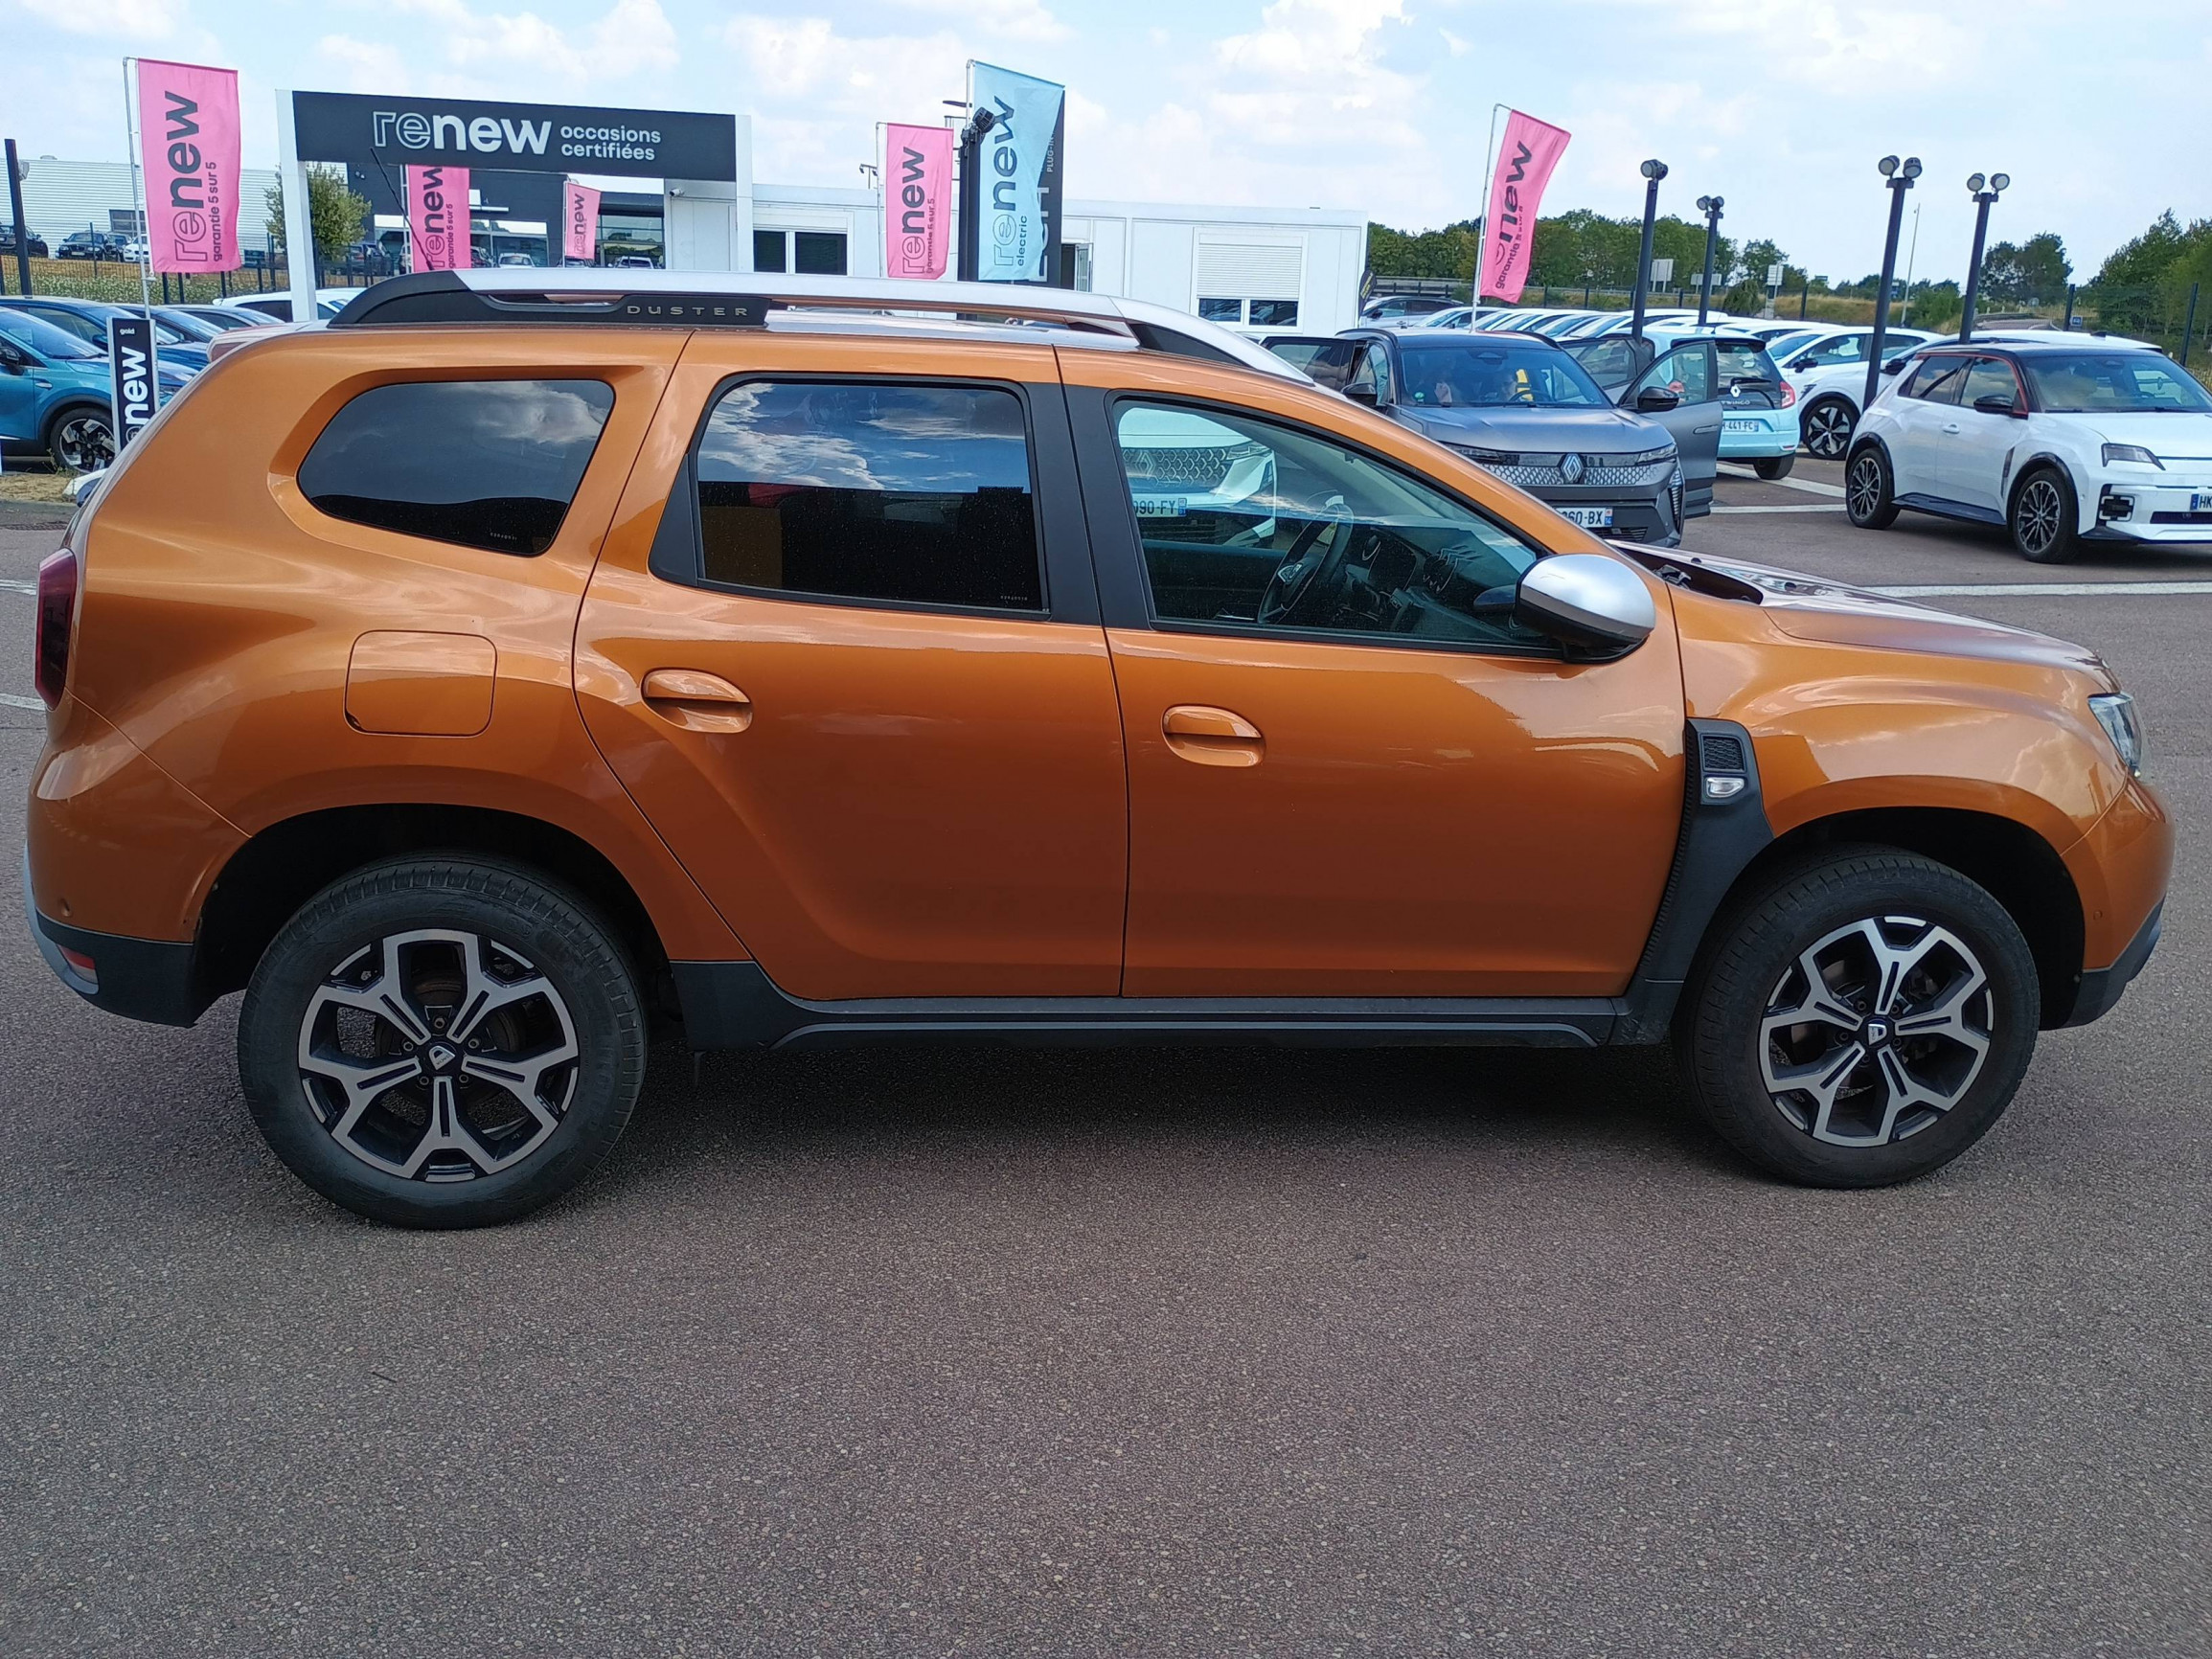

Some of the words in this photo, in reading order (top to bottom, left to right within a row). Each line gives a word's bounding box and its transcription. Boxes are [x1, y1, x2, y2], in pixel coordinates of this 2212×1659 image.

[373, 111, 553, 154] renew
[560, 125, 661, 144] occasions
[560, 142, 655, 161] certifiées
[165, 90, 208, 262] renew
[205, 161, 217, 170] 5
[208, 171, 218, 193] sur
[992, 95, 1017, 266] renew
[208, 195, 219, 204] 5
[422, 167, 445, 268] renew
[901, 146, 925, 274] renew
[208, 206, 223, 262] garantie
[1017, 216, 1027, 266] electric
[627, 306, 747, 316] DUSTER
